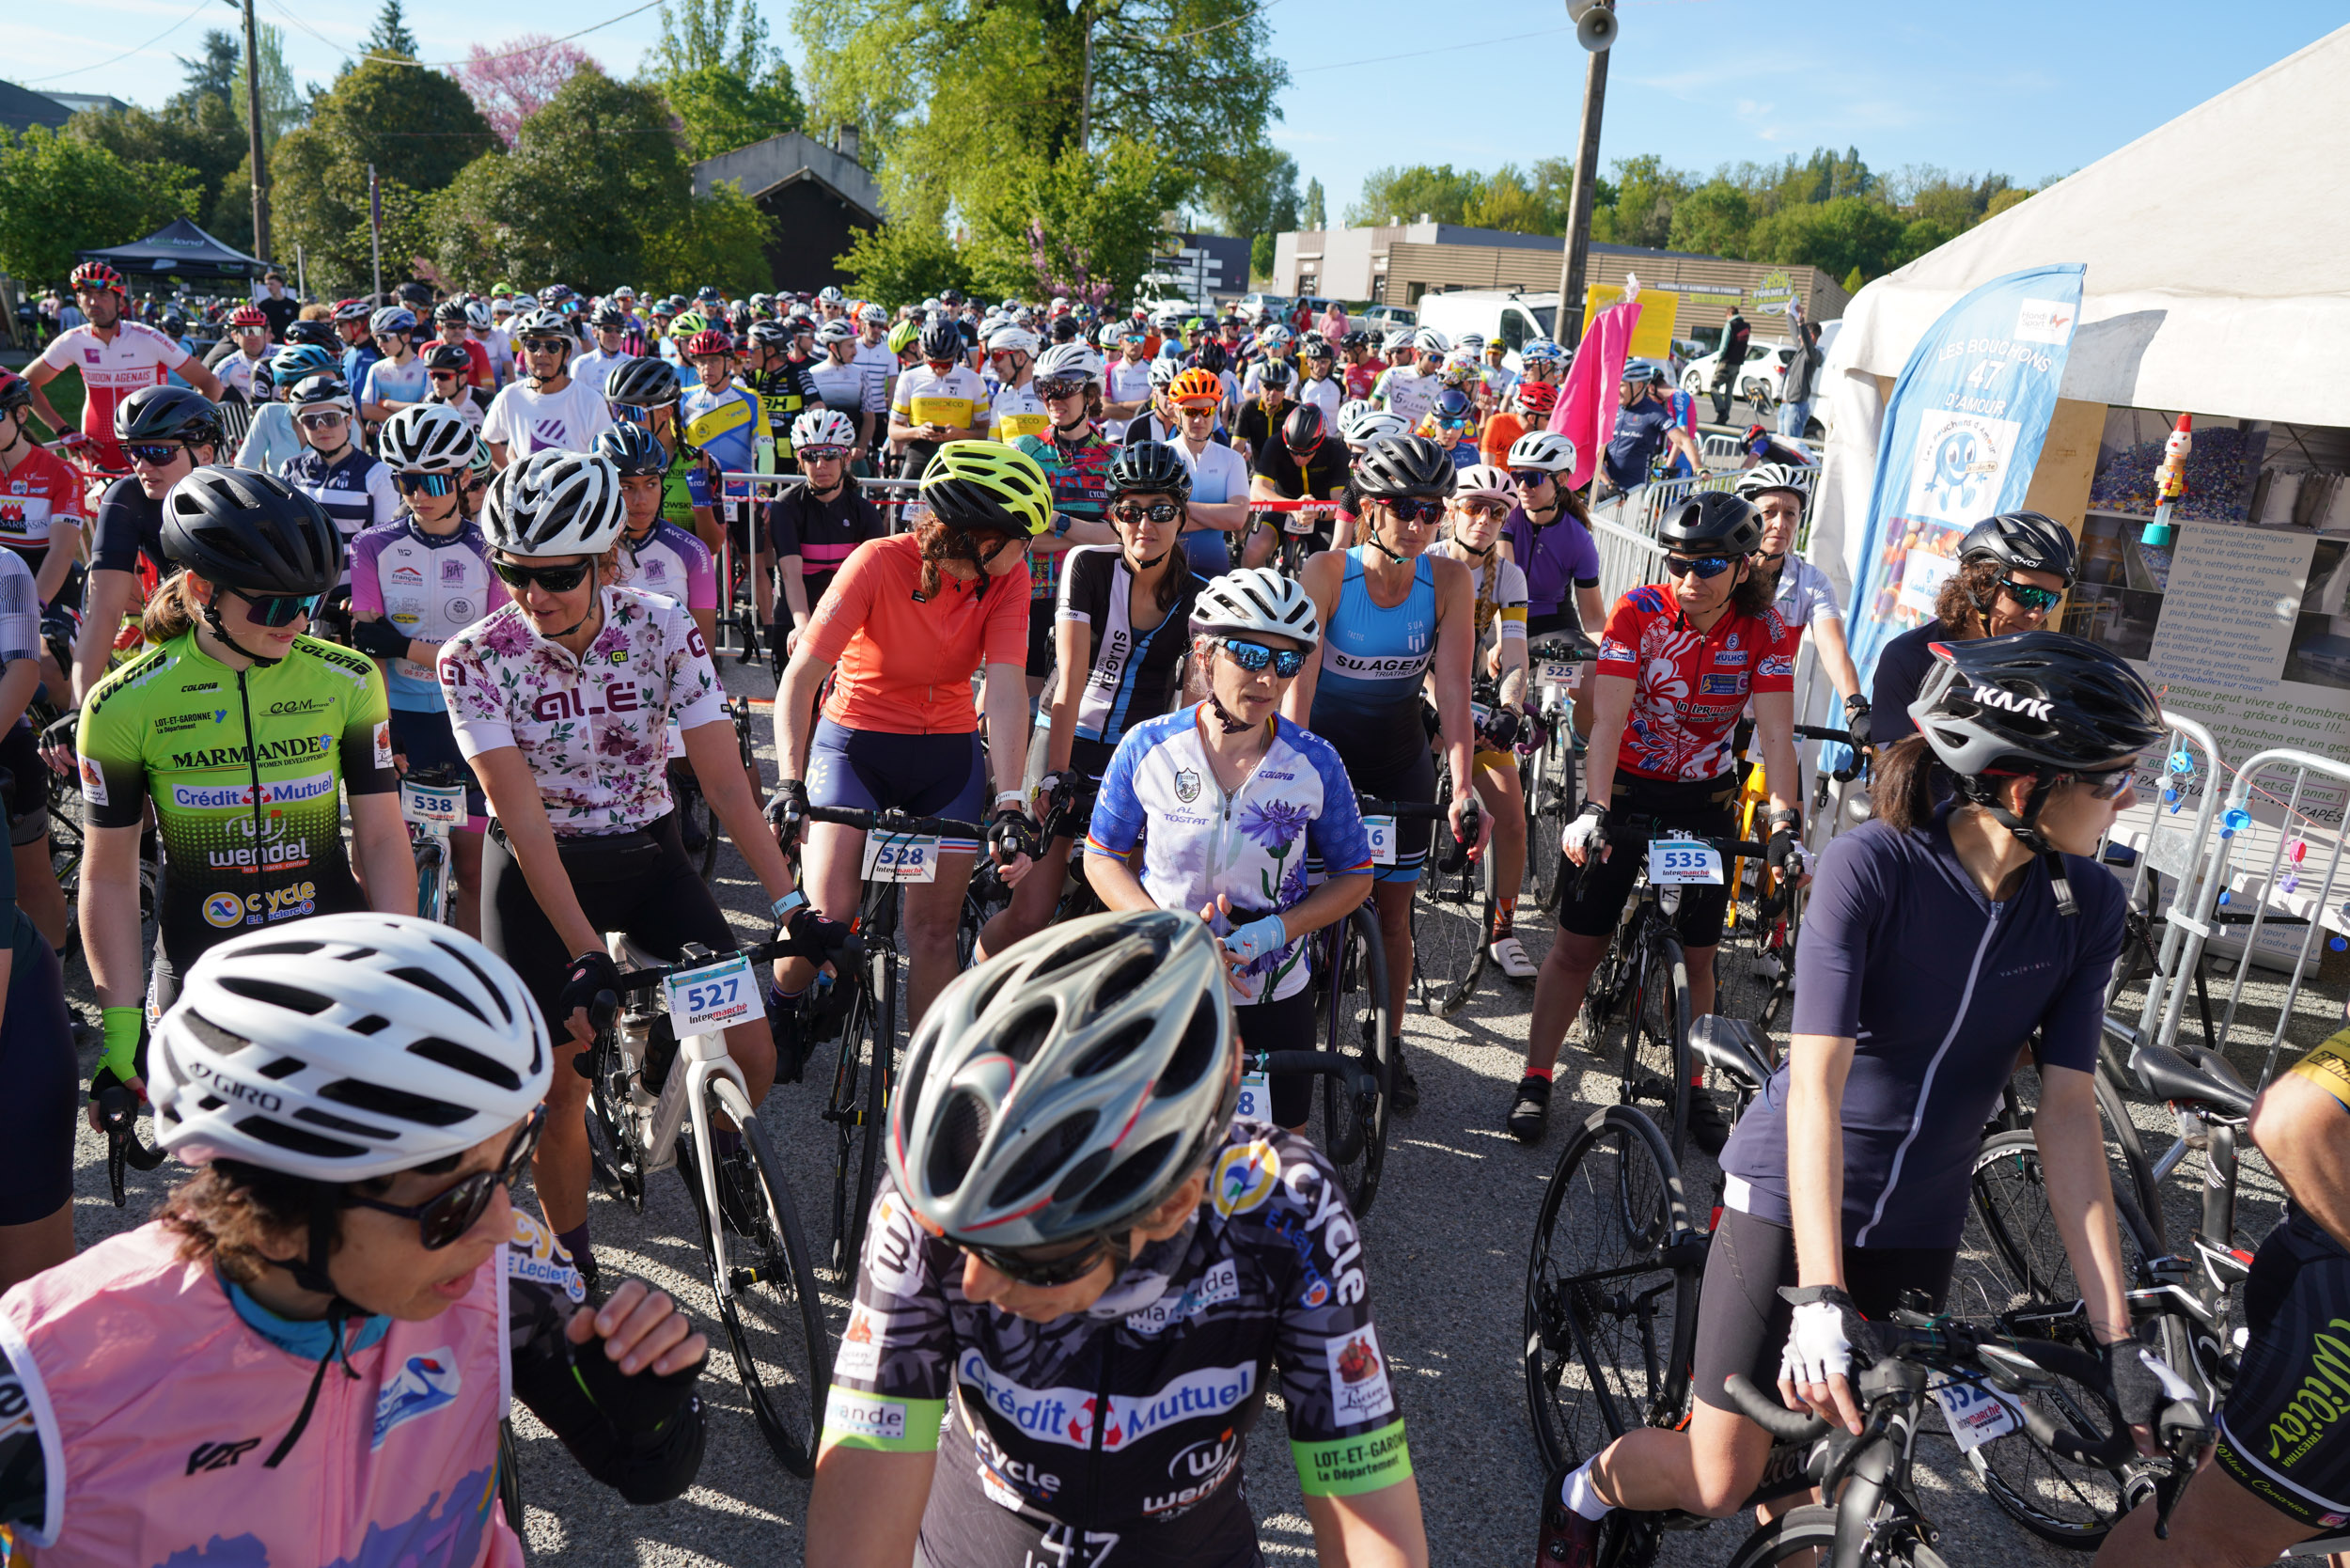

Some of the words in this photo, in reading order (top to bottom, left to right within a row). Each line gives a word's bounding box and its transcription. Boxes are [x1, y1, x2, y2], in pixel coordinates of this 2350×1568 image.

[1938, 340, 1965, 362] LES
[1967, 338, 2052, 373] BOUCHONS
[115, 370, 150, 382] AGENAIS
[1966, 360, 2005, 390] 47
[1945, 395, 2006, 416] D'AMOUR
[353, 523, 400, 544] LIBOURNE
[2201, 525, 2244, 539] bouchons
[2246, 532, 2294, 544] plastiques
[2203, 538, 2223, 546] sont
[2226, 540, 2264, 551] collectés
[683, 536, 709, 575] LIBOURNE
[2195, 546, 2215, 555] tout
[2227, 550, 2287, 564] département
[2204, 559, 2244, 572] nettoyés
[2257, 566, 2292, 576] stockés
[391, 573, 423, 583] Français
[2225, 574, 2264, 587] expédiés
[2168, 588, 2183, 597] par
[2185, 590, 2223, 602] camions
[2239, 596, 2251, 604] 70
[2177, 580, 2197, 588] vers
[2198, 580, 2226, 591] l'usine
[2242, 588, 2286, 600] recyclage
[2169, 609, 2187, 619] puis
[2188, 610, 2220, 621] fondus
[2188, 603, 2208, 611] sont
[2210, 604, 2240, 617] broyés
[2255, 611, 2295, 622] copeaux
[1407, 621, 1423, 630] SUA
[2160, 620, 2182, 631] Cette
[2185, 624, 2222, 635] nouvelle
[2224, 630, 2261, 641] matière
[2157, 631, 2170, 639] est
[2172, 632, 2213, 644] utilisable
[2214, 639, 2235, 650] pour
[2238, 642, 2272, 653] réaliser
[290, 638, 374, 677] COLOMB
[1100, 630, 1127, 692] SU.AGEN
[2154, 639, 2170, 649] des
[2172, 642, 2201, 656] objets
[2202, 645, 2238, 660] d'usage
[2239, 652, 2273, 665] courant
[1336, 654, 1427, 672] SU.AGEN
[1547, 666, 1573, 677] 525
[2161, 651, 2191, 664] Comme
[2192, 656, 2209, 666] des
[2212, 658, 2250, 673] palettes
[89, 649, 168, 714] COLOMB
[1374, 666, 1420, 678] TRIATHLON
[2147, 660, 2158, 668] de
[2159, 662, 2202, 678] transport
[2204, 668, 2216, 677] de
[2217, 670, 2280, 687] marchandises
[181, 682, 218, 693] COLOMB
[2179, 673, 2221, 687] Poubelles
[2240, 682, 2264, 692] roues
[1676, 699, 1747, 716] Intermar
[1973, 685, 2055, 722] KASK
[2157, 683, 2212, 701] plastique
[2213, 691, 2242, 706] peut
[2245, 696, 2275, 709] vivre
[2277, 699, 2292, 712] de
[2295, 705, 2350, 721] nombreu
[154, 712, 212, 728] LOT-ET-GARONNE
[2168, 696, 2226, 714] successifs
[2292, 718, 2321, 730] vous
[164, 723, 196, 734] Département
[2213, 722, 2228, 732] un
[2231, 726, 2283, 743] bouchon
[2286, 734, 2306, 745] est
[2310, 739, 2325, 749] un
[2327, 741, 2350, 755] ges
[2217, 735, 2232, 746] de
[2232, 737, 2263, 751] faire
[172, 736, 321, 769] MARMANDE
[2232, 755, 2243, 764] et
[257, 760, 283, 770] WOMEN
[2276, 762, 2288, 773] la
[1259, 770, 1295, 781] COLOMB
[176, 787, 241, 806] Crédit
[273, 774, 333, 801] Mutuel
[415, 795, 452, 812] 538
[1177, 807, 1195, 815] AL
[413, 809, 455, 820] Intermarché
[1164, 813, 1210, 826] TOSTAT
[209, 837, 311, 868] wendel
[880, 847, 923, 865] 528
[1665, 852, 1707, 868] 535
[285, 860, 308, 869] confort
[875, 866, 923, 876] Intermarché
[1663, 870, 1710, 878] Intermarché
[245, 881, 316, 910] cycle
[688, 979, 739, 1012] 527
[689, 1002, 747, 1025] Intermarché
[213, 1073, 283, 1112] GIRO
[1285, 1162, 1367, 1307] cycle
[964, 1355, 1066, 1435] Crédit
[1128, 1370, 1250, 1440] Mutuel
[2281, 1431, 2324, 1468] TRIESTINA
[975, 1429, 1061, 1493] cycle
[1318, 1469, 1331, 1482] Le
[1334, 1456, 1400, 1482] Département
